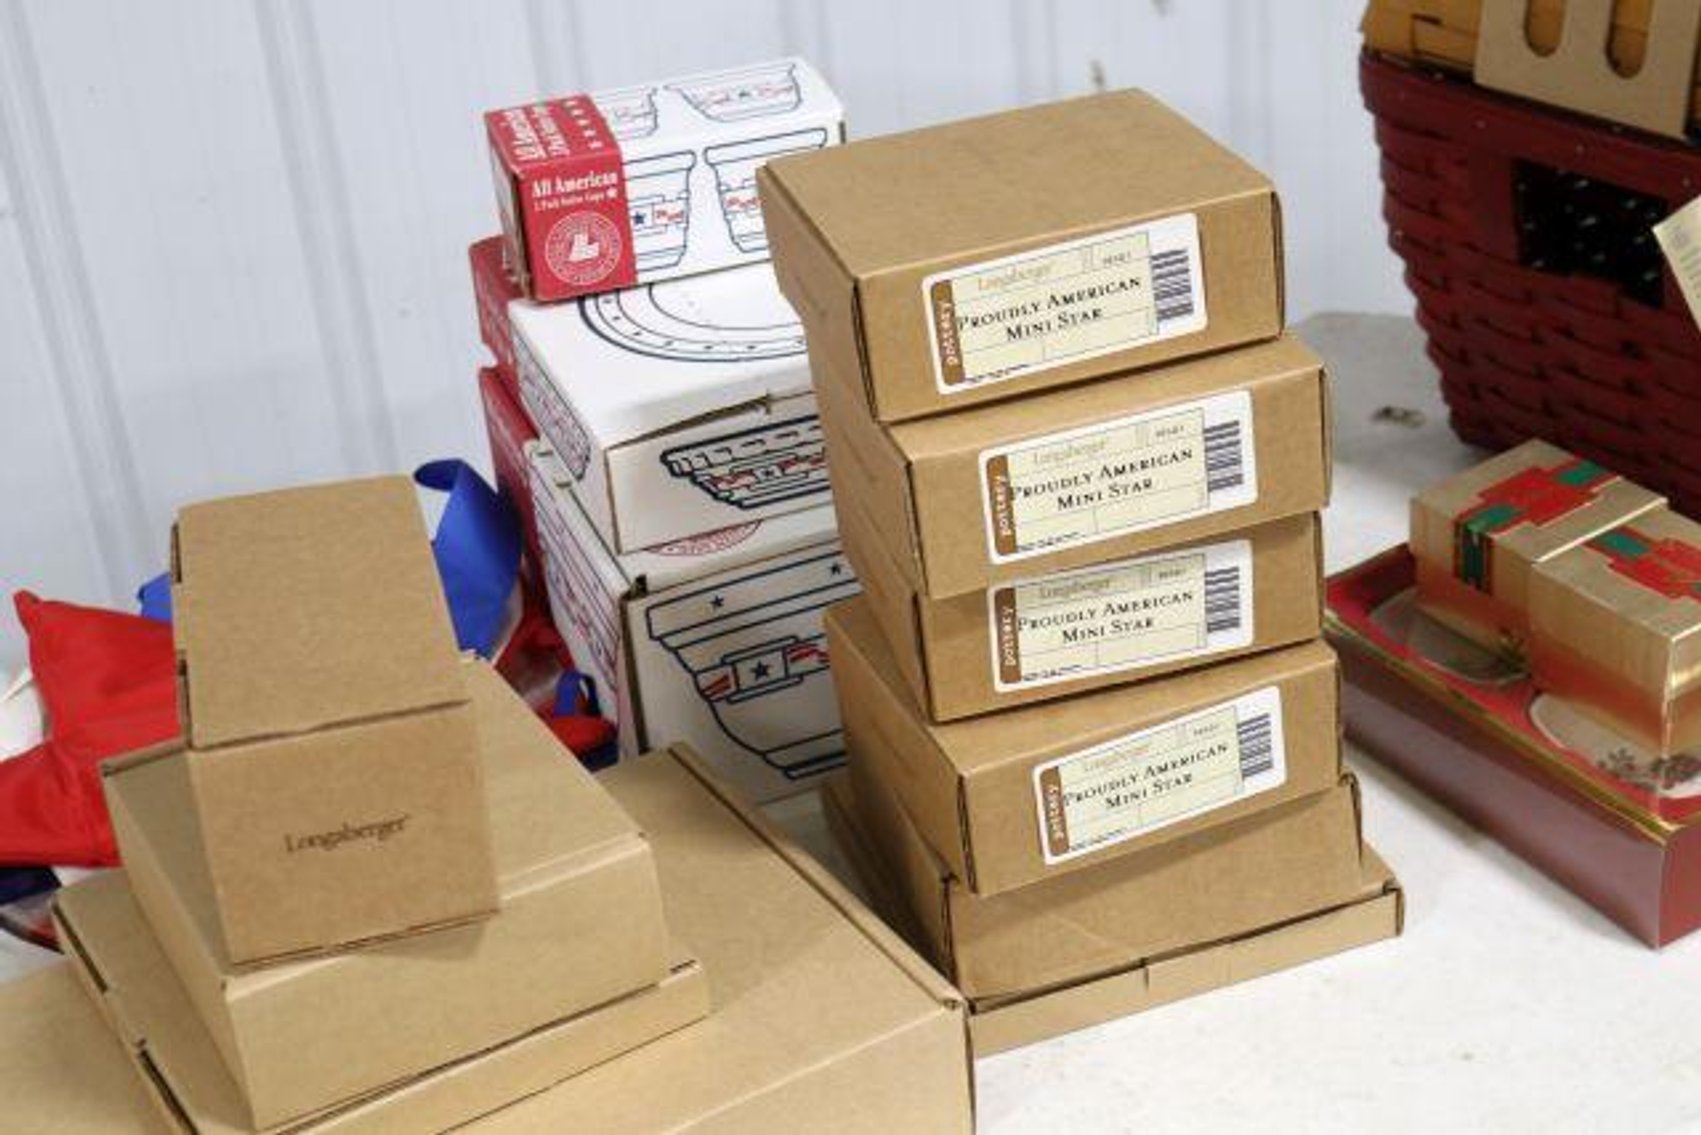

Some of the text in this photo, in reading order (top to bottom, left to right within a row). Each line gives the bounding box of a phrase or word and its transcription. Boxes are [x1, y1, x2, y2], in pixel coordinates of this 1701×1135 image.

[532, 170, 618, 198] All American
[959, 277, 1142, 332] PROUDLY AMERICAN
[1006, 308, 1104, 342] MINI STAR
[1013, 448, 1194, 500] PROUDLY AMERICAN
[1056, 478, 1154, 512] MINI STAR
[1017, 591, 1194, 632] PROUDLY AMERICAN
[1061, 615, 1155, 645] MINI STAR
[1063, 773, 1140, 808] PROUDLY
[1143, 742, 1229, 779] AMERICAN
[1104, 772, 1195, 811] MINI STAR
